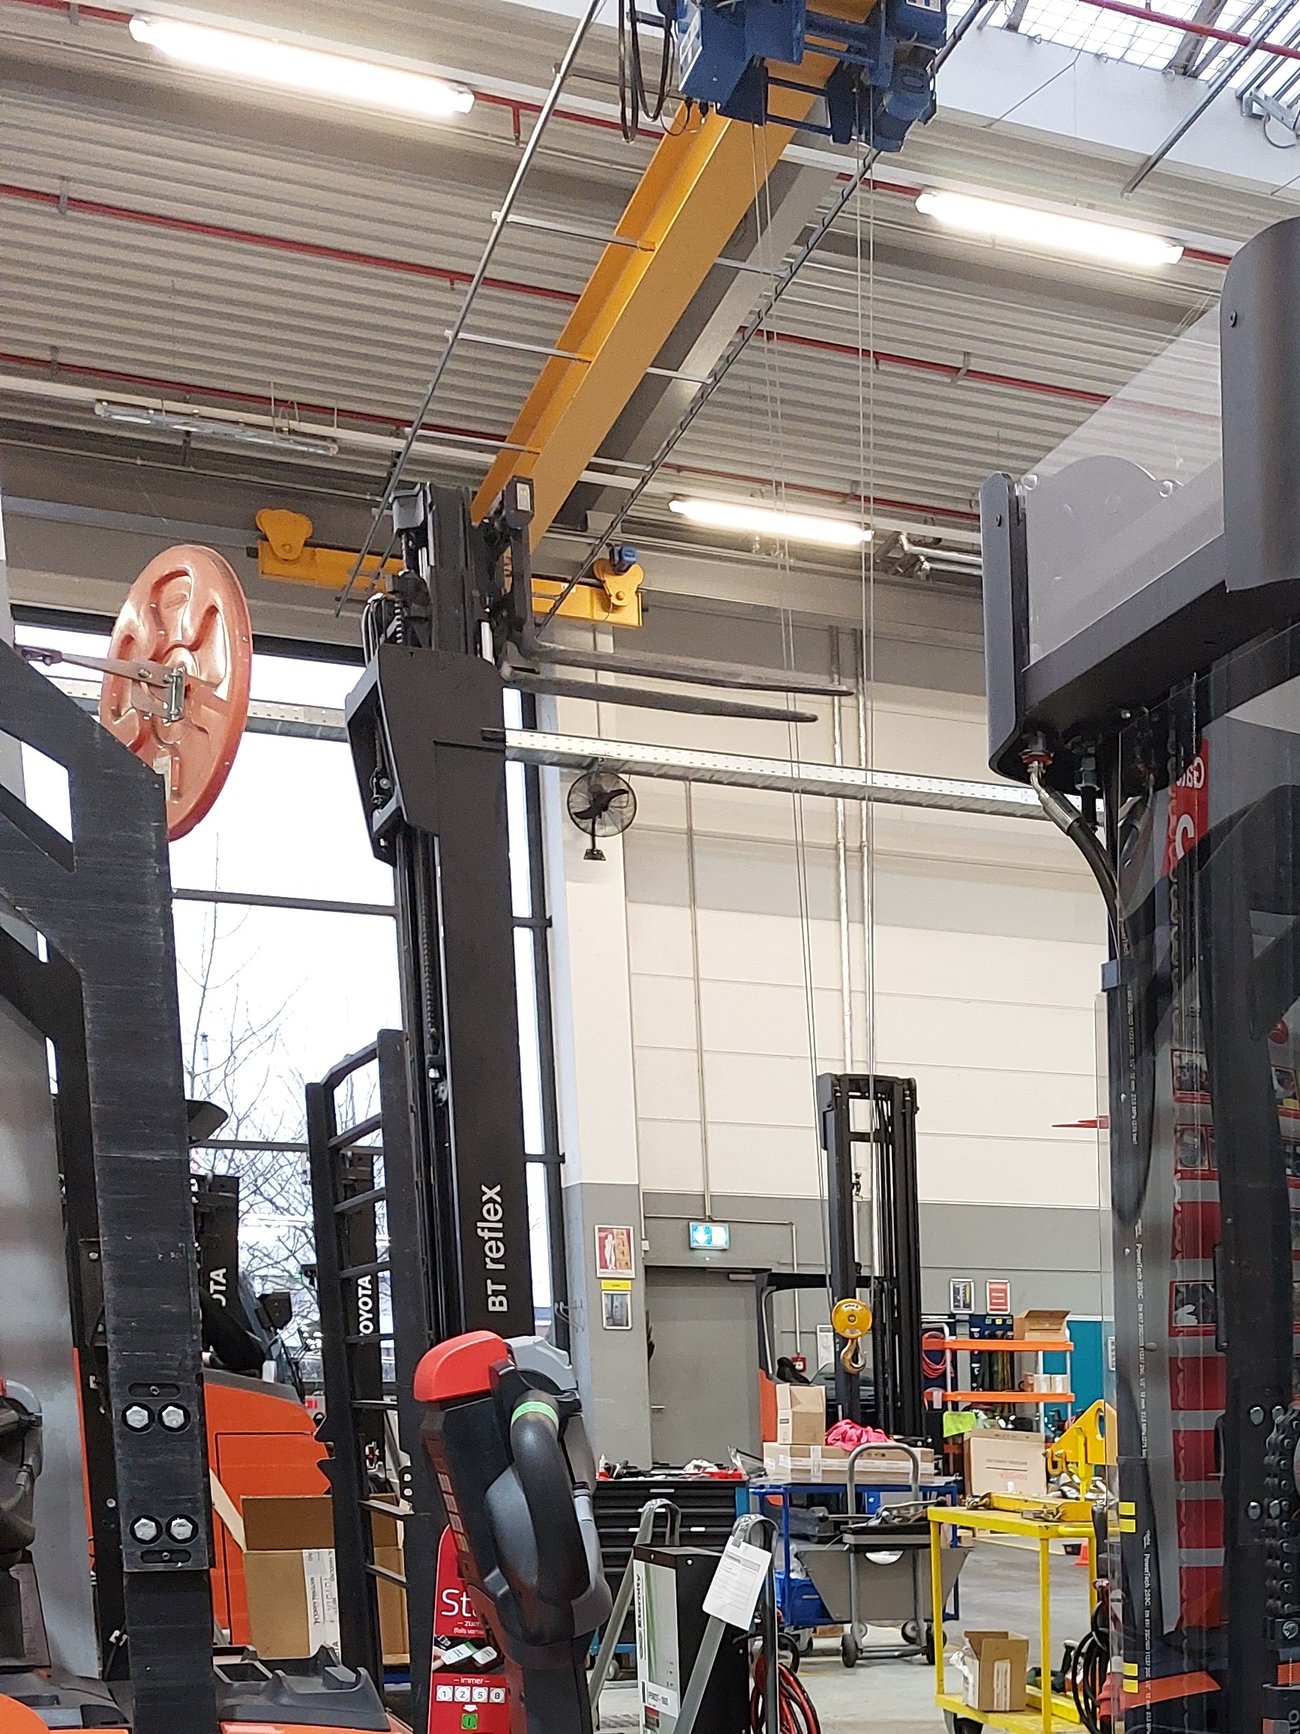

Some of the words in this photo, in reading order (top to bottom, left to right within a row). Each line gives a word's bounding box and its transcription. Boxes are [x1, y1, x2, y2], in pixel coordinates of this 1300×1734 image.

[477, 1184, 507, 1270] reflex
[358, 1275, 374, 1336] OYOTA
[486, 1279, 508, 1313] BT
